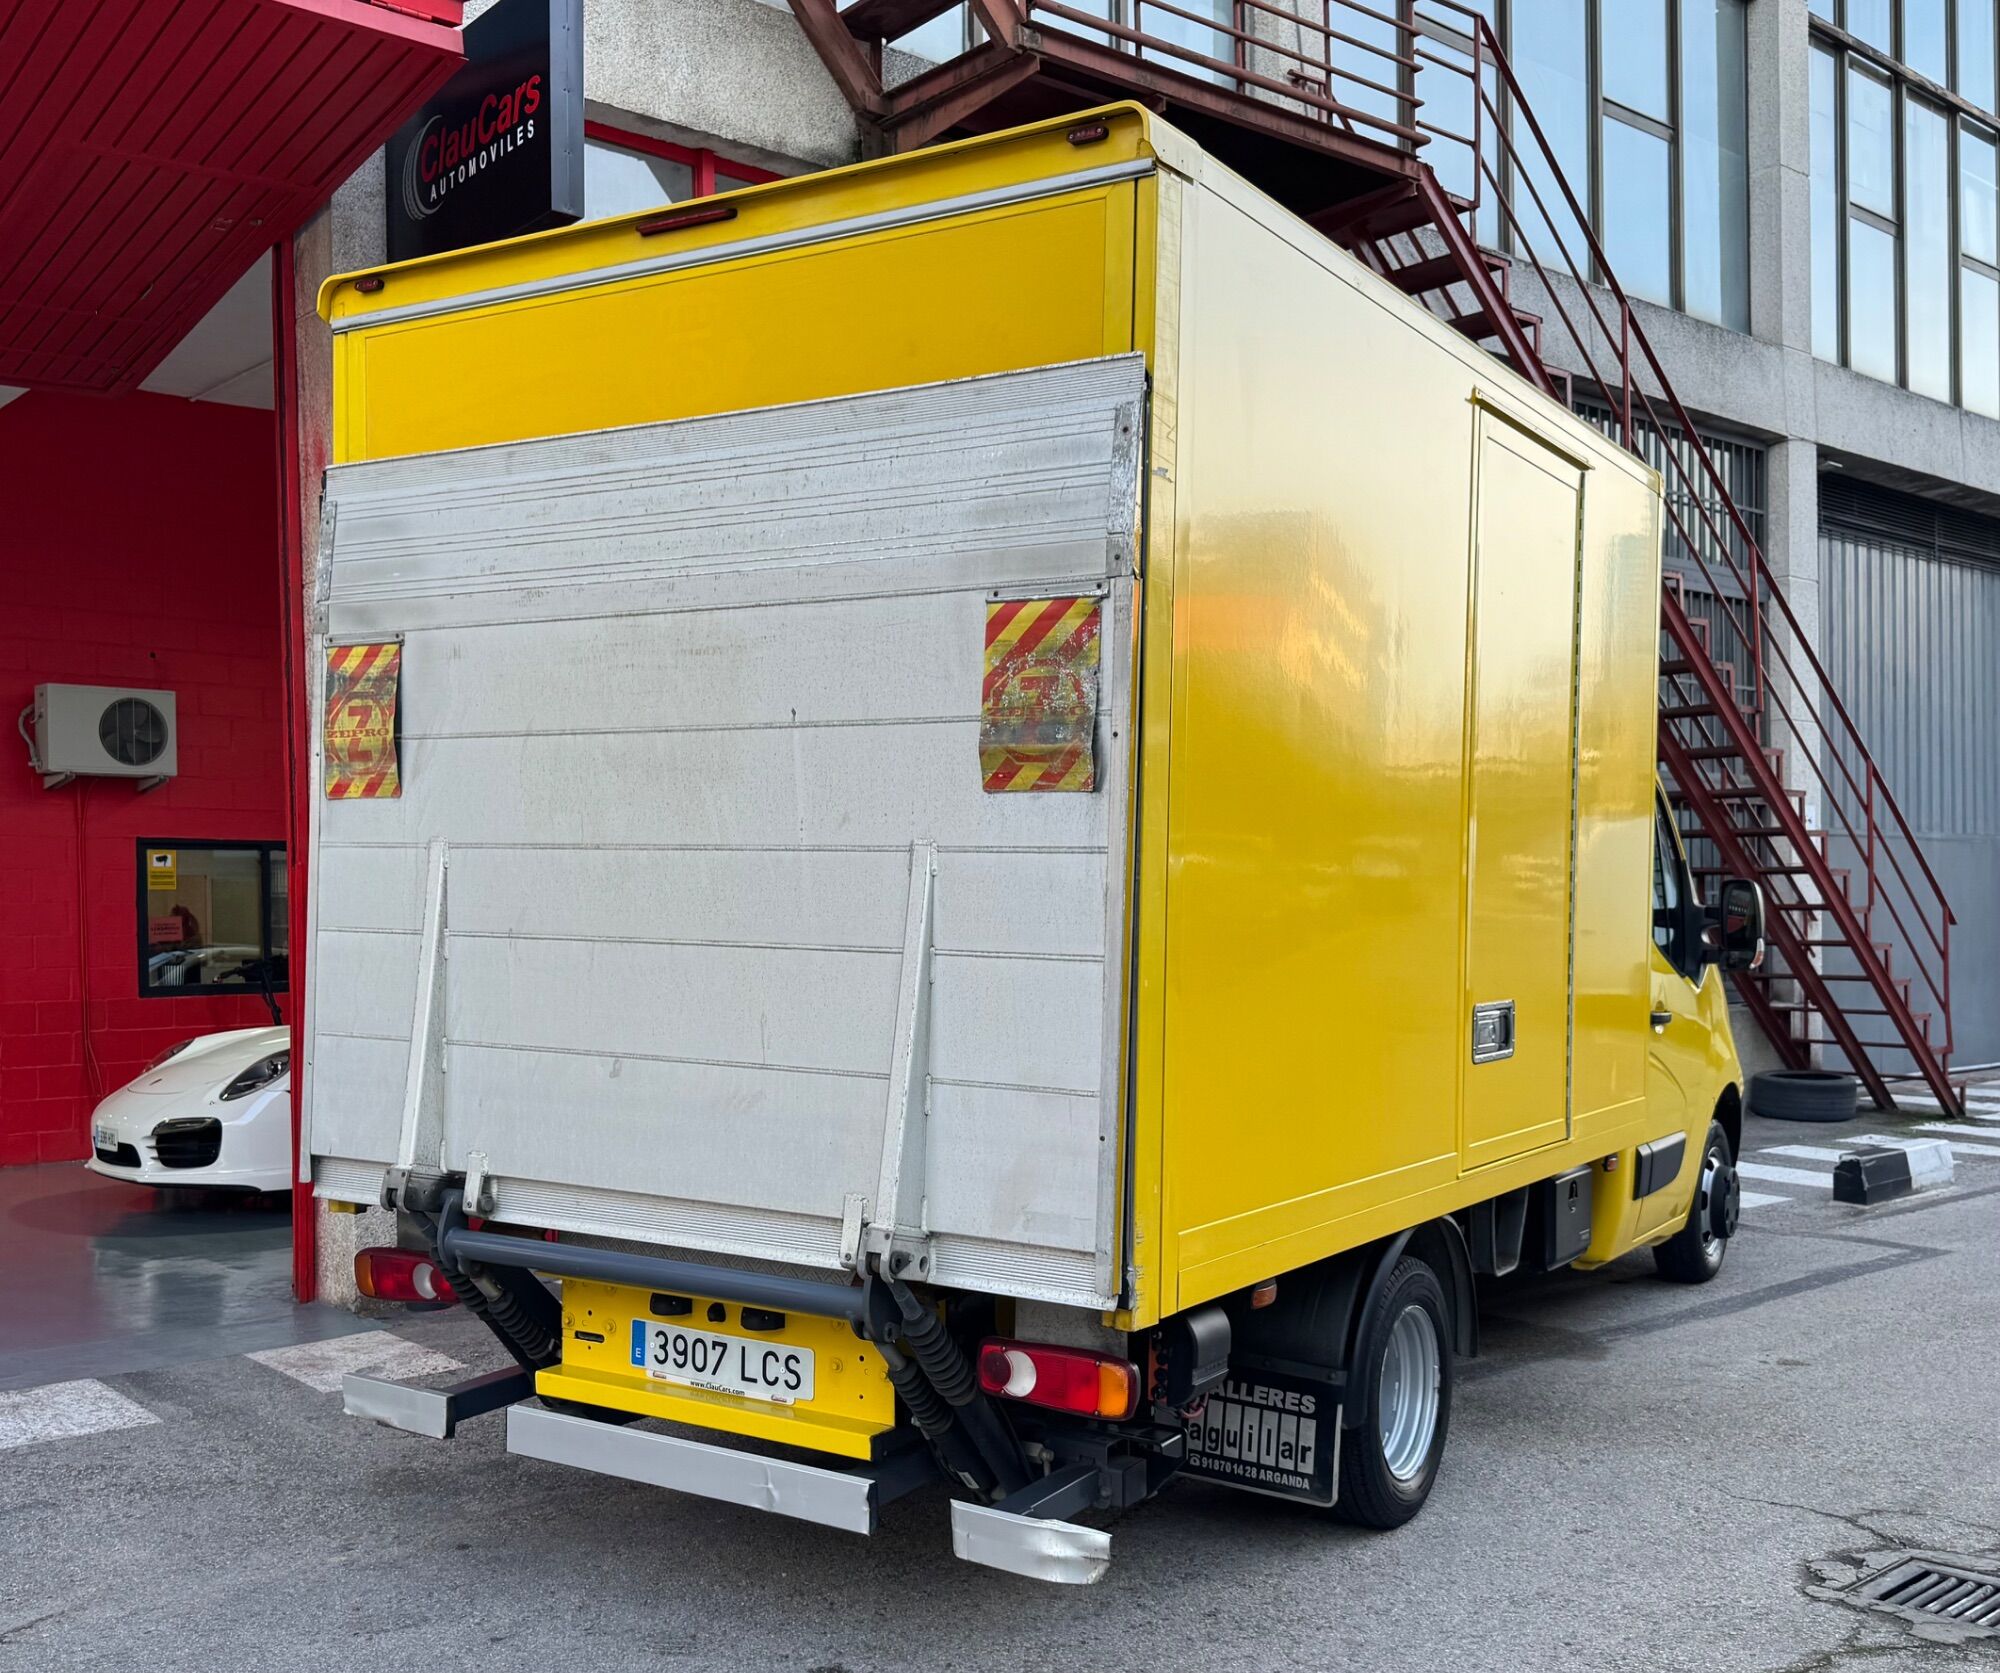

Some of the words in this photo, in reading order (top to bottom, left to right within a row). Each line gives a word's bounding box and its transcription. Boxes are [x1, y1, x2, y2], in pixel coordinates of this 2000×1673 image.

[421, 74, 541, 183] ClauCars
[430, 119, 535, 202] AUTOMOVILES
[327, 728, 389, 739] ZEPRO
[635, 1347, 642, 1358] E
[653, 1330, 728, 1376] 3907
[741, 1345, 802, 1390] LCS
[690, 1380, 745, 1396] www.ClauCars.com
[1190, 1422, 1312, 1464] aguilar
[1259, 1469, 1310, 1491] ARGANDA
